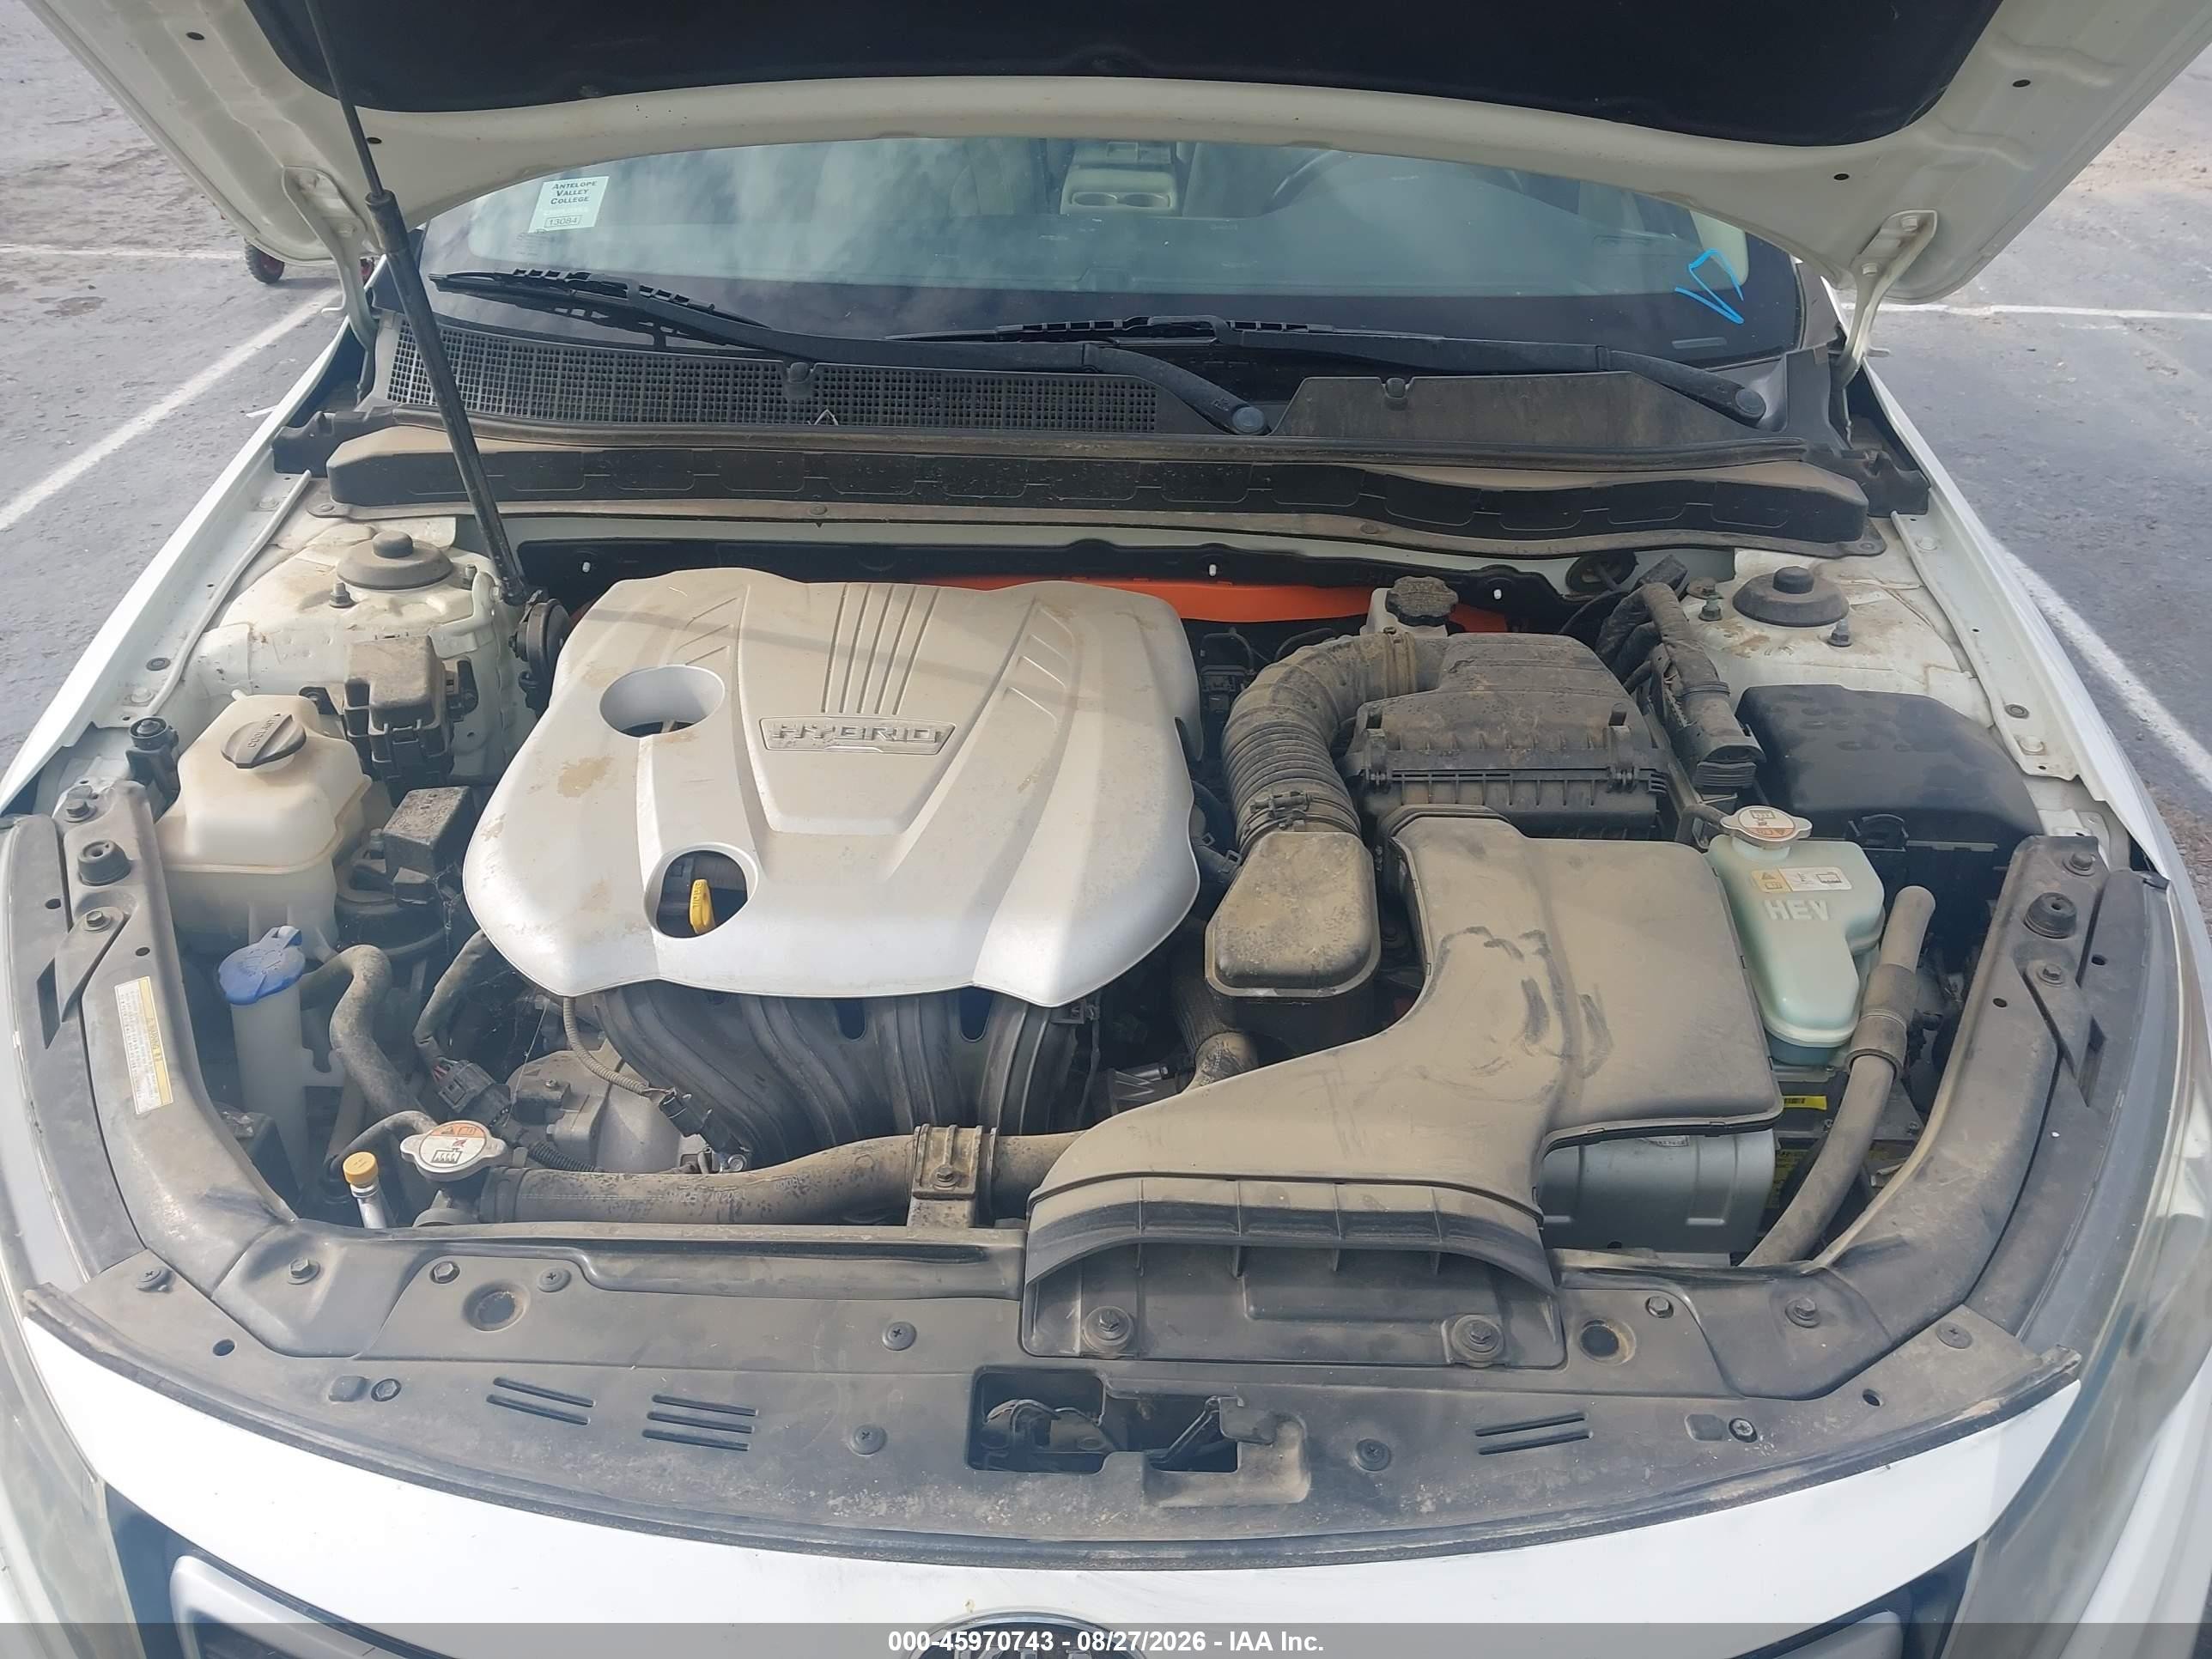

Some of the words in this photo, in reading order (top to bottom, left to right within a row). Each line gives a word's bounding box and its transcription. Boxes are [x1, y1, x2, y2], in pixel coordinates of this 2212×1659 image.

[552, 180, 599, 190] ANTELOPE
[550, 196, 591, 204] COLLEGE
[247, 719, 276, 748] COOLANT
[772, 724, 943, 744] HYBRID
[1764, 899, 1831, 921] HEV
